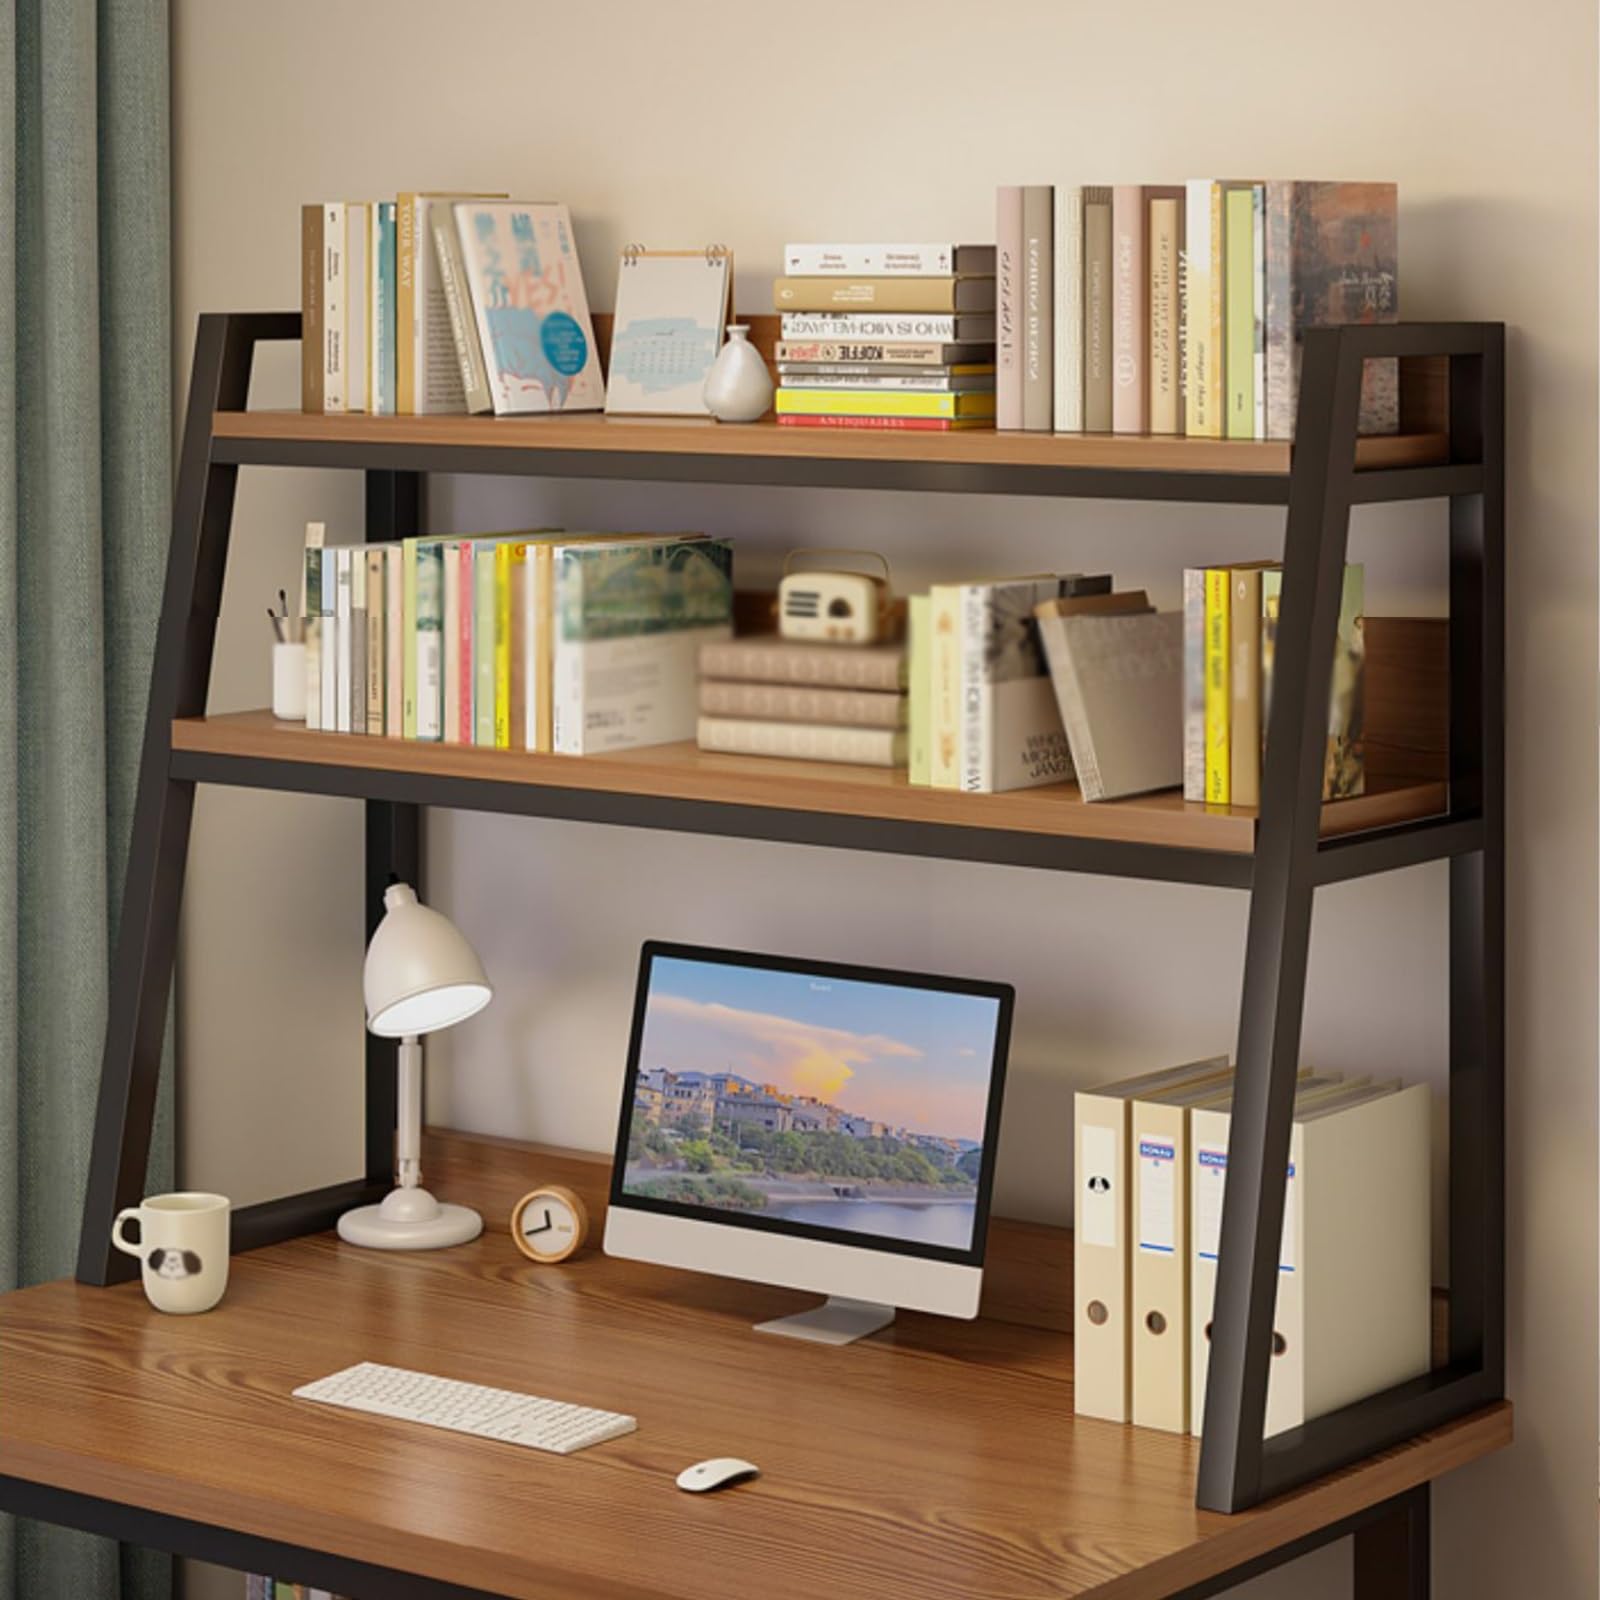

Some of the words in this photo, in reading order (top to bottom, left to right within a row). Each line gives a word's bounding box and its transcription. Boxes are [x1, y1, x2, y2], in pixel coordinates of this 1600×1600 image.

[402, 204, 411, 247] YOUR
[402, 255, 412, 288] WAY
[831, 321, 894, 335] MICHAEL
[897, 322, 912, 336] IS
[915, 322, 953, 336] WHO
[839, 346, 883, 360] KOFFIE
